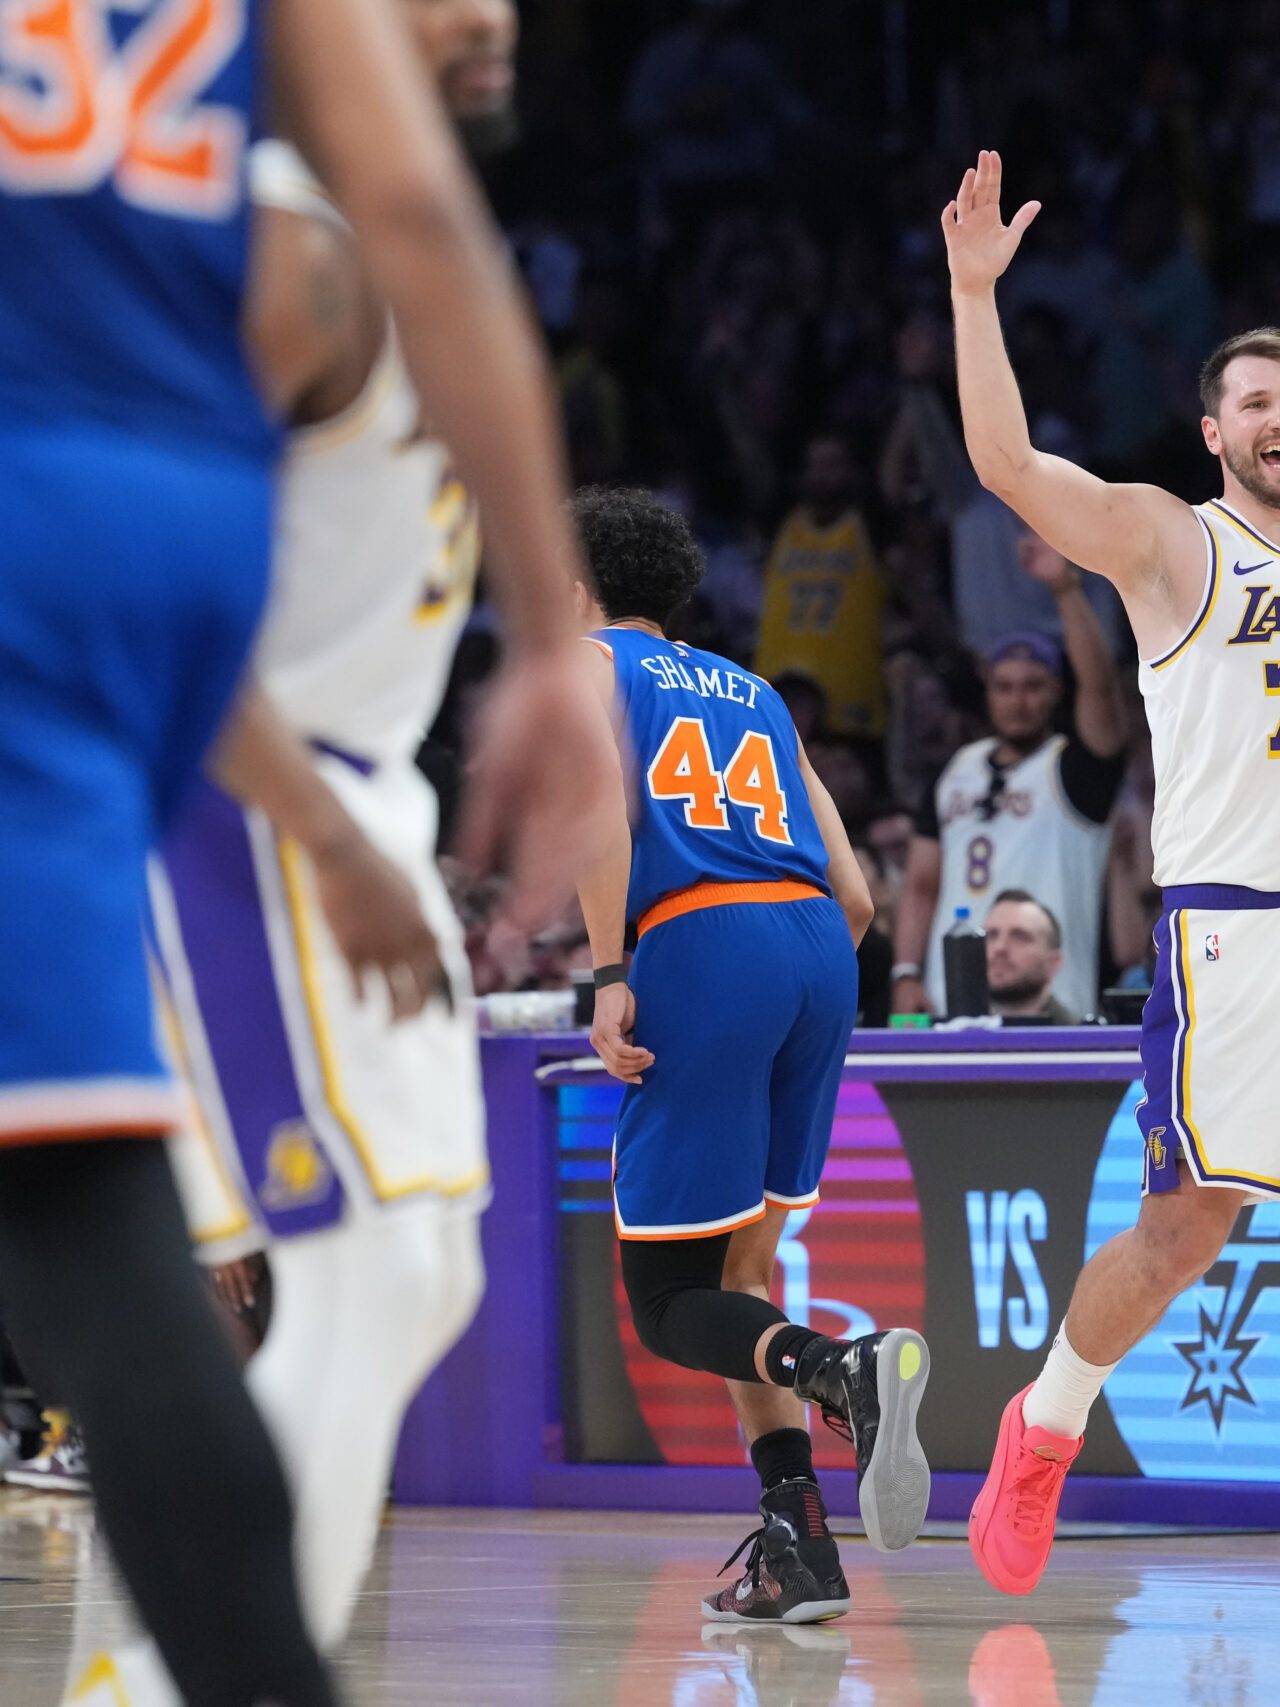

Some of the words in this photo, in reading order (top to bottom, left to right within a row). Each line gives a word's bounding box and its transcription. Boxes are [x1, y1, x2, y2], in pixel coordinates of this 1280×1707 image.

[641, 655, 760, 709] SHAMET
[647, 716, 795, 846] 44
[967, 835, 992, 896] 8
[965, 1188, 1049, 1351] VS
